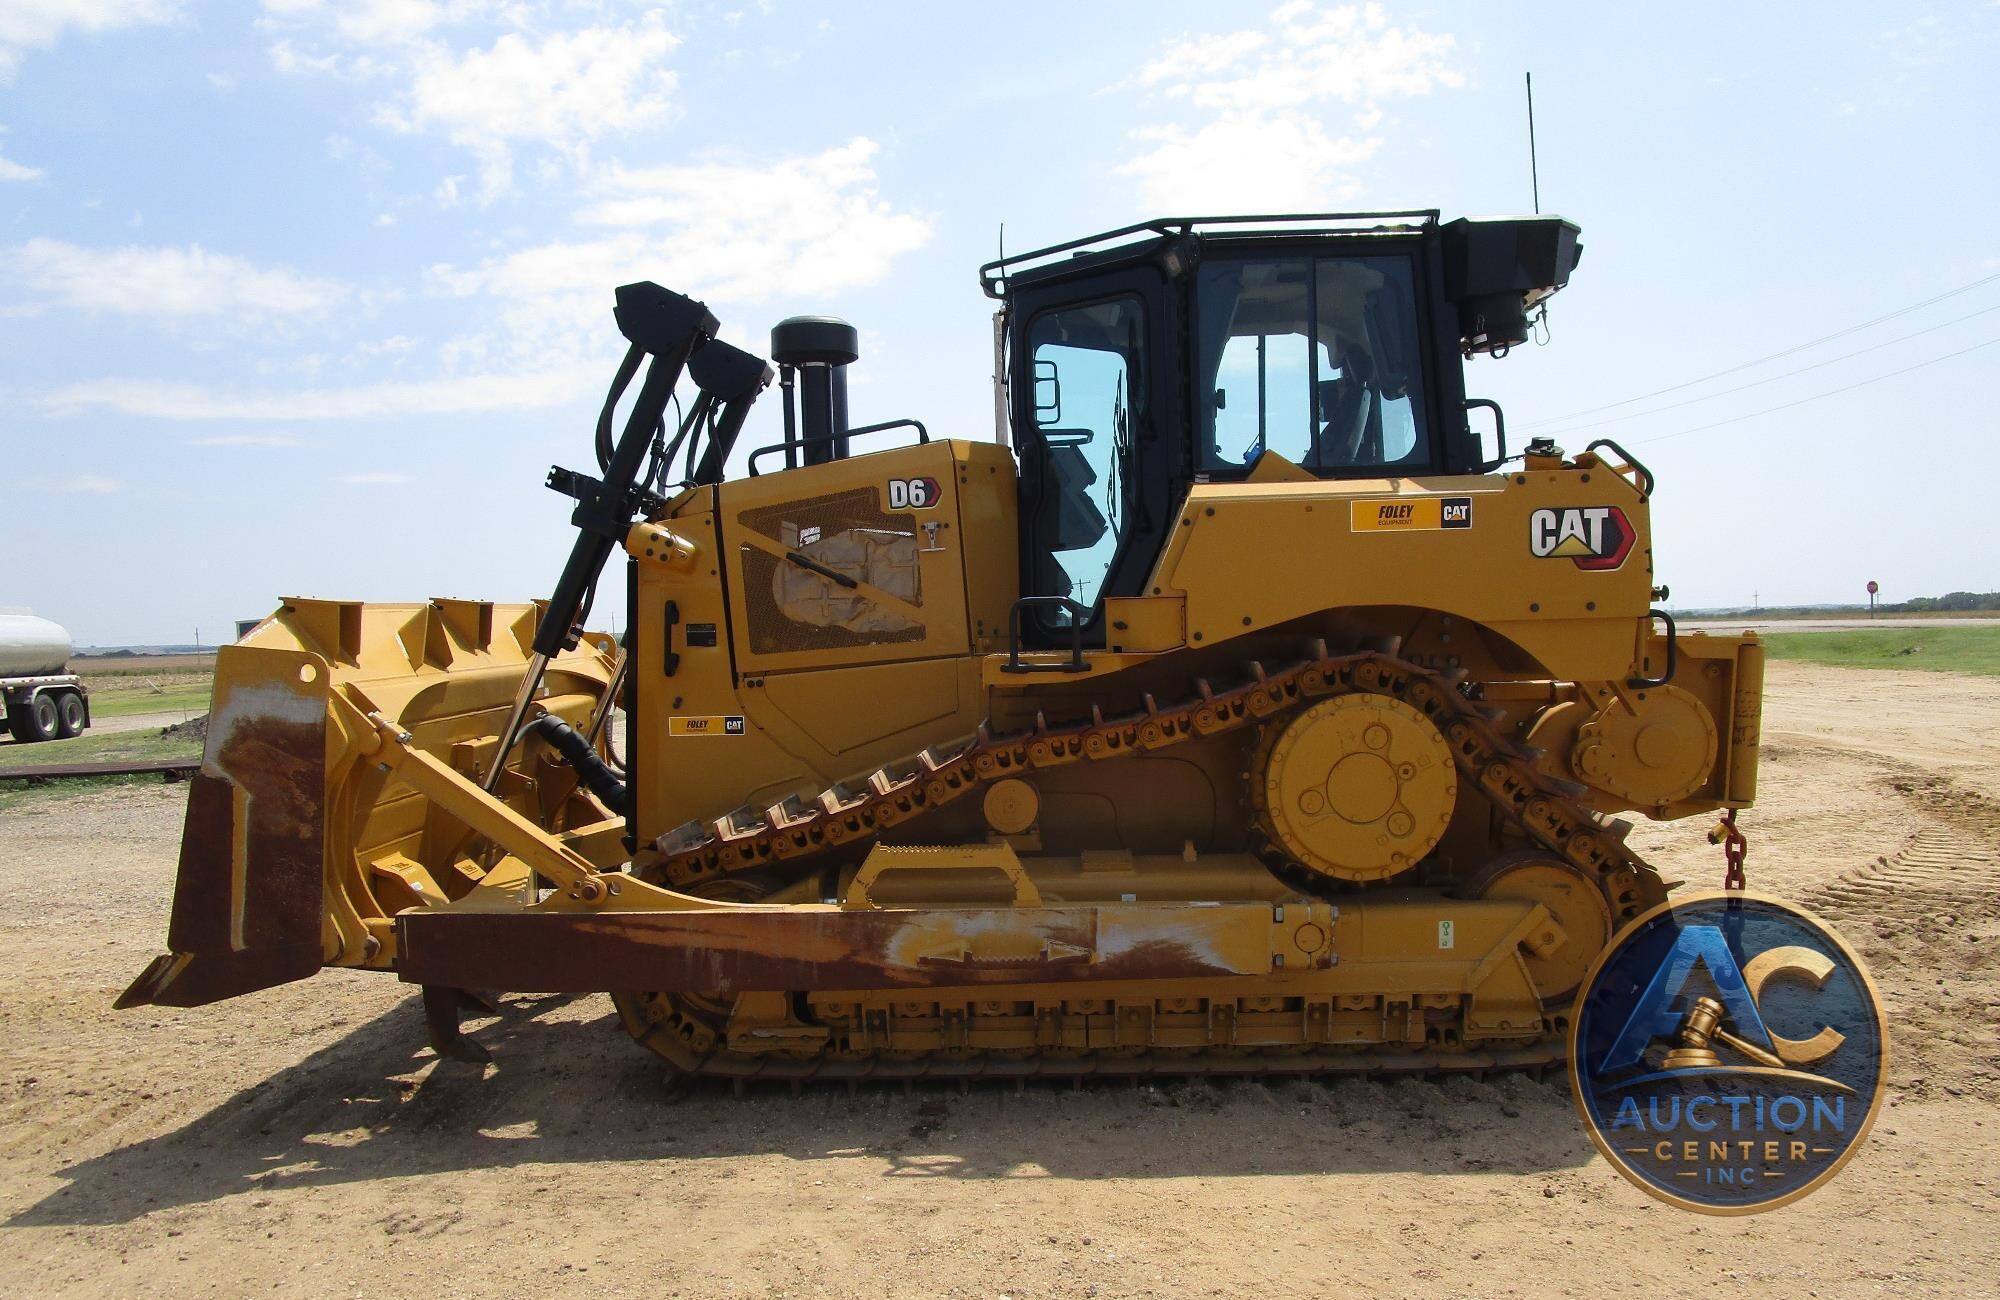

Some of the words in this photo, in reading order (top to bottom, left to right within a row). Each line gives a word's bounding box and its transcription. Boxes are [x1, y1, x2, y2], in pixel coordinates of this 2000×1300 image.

[890, 480, 925, 507] D6
[1379, 505, 1414, 518] FOLEY
[1444, 505, 1468, 520] CAT
[1532, 508, 1609, 557] CAT
[687, 720, 708, 728] FOLEY
[726, 721, 742, 730] CAT
